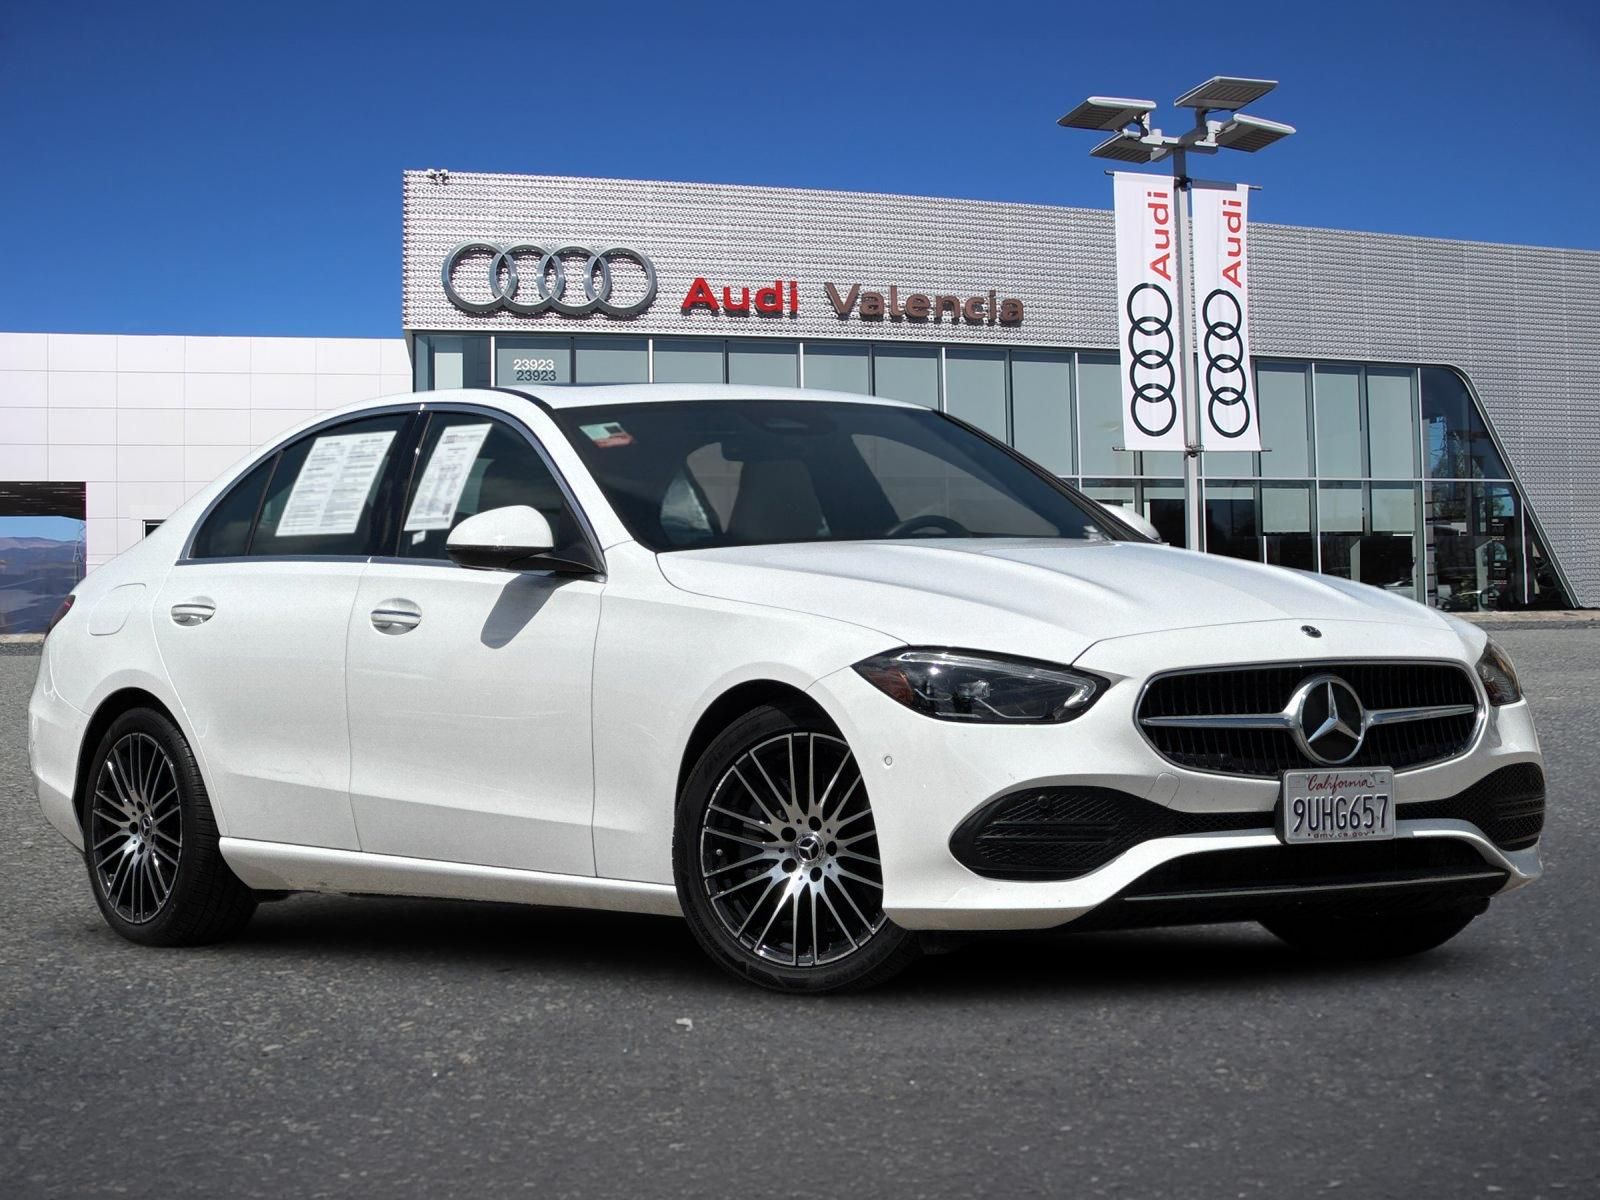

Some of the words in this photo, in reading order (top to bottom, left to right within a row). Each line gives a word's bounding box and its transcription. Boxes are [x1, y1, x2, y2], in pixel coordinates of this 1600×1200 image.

[1147, 191, 1171, 281] Audi
[1222, 199, 1242, 288] Audi
[681, 277, 799, 315] Audi
[825, 281, 1024, 324] Valencia
[513, 359, 554, 370] 23923
[516, 370, 557, 382] 23923
[1307, 774, 1375, 795] California
[1293, 795, 1388, 833] 9UHG657
[1313, 831, 1370, 839] dmv.ca.gov
